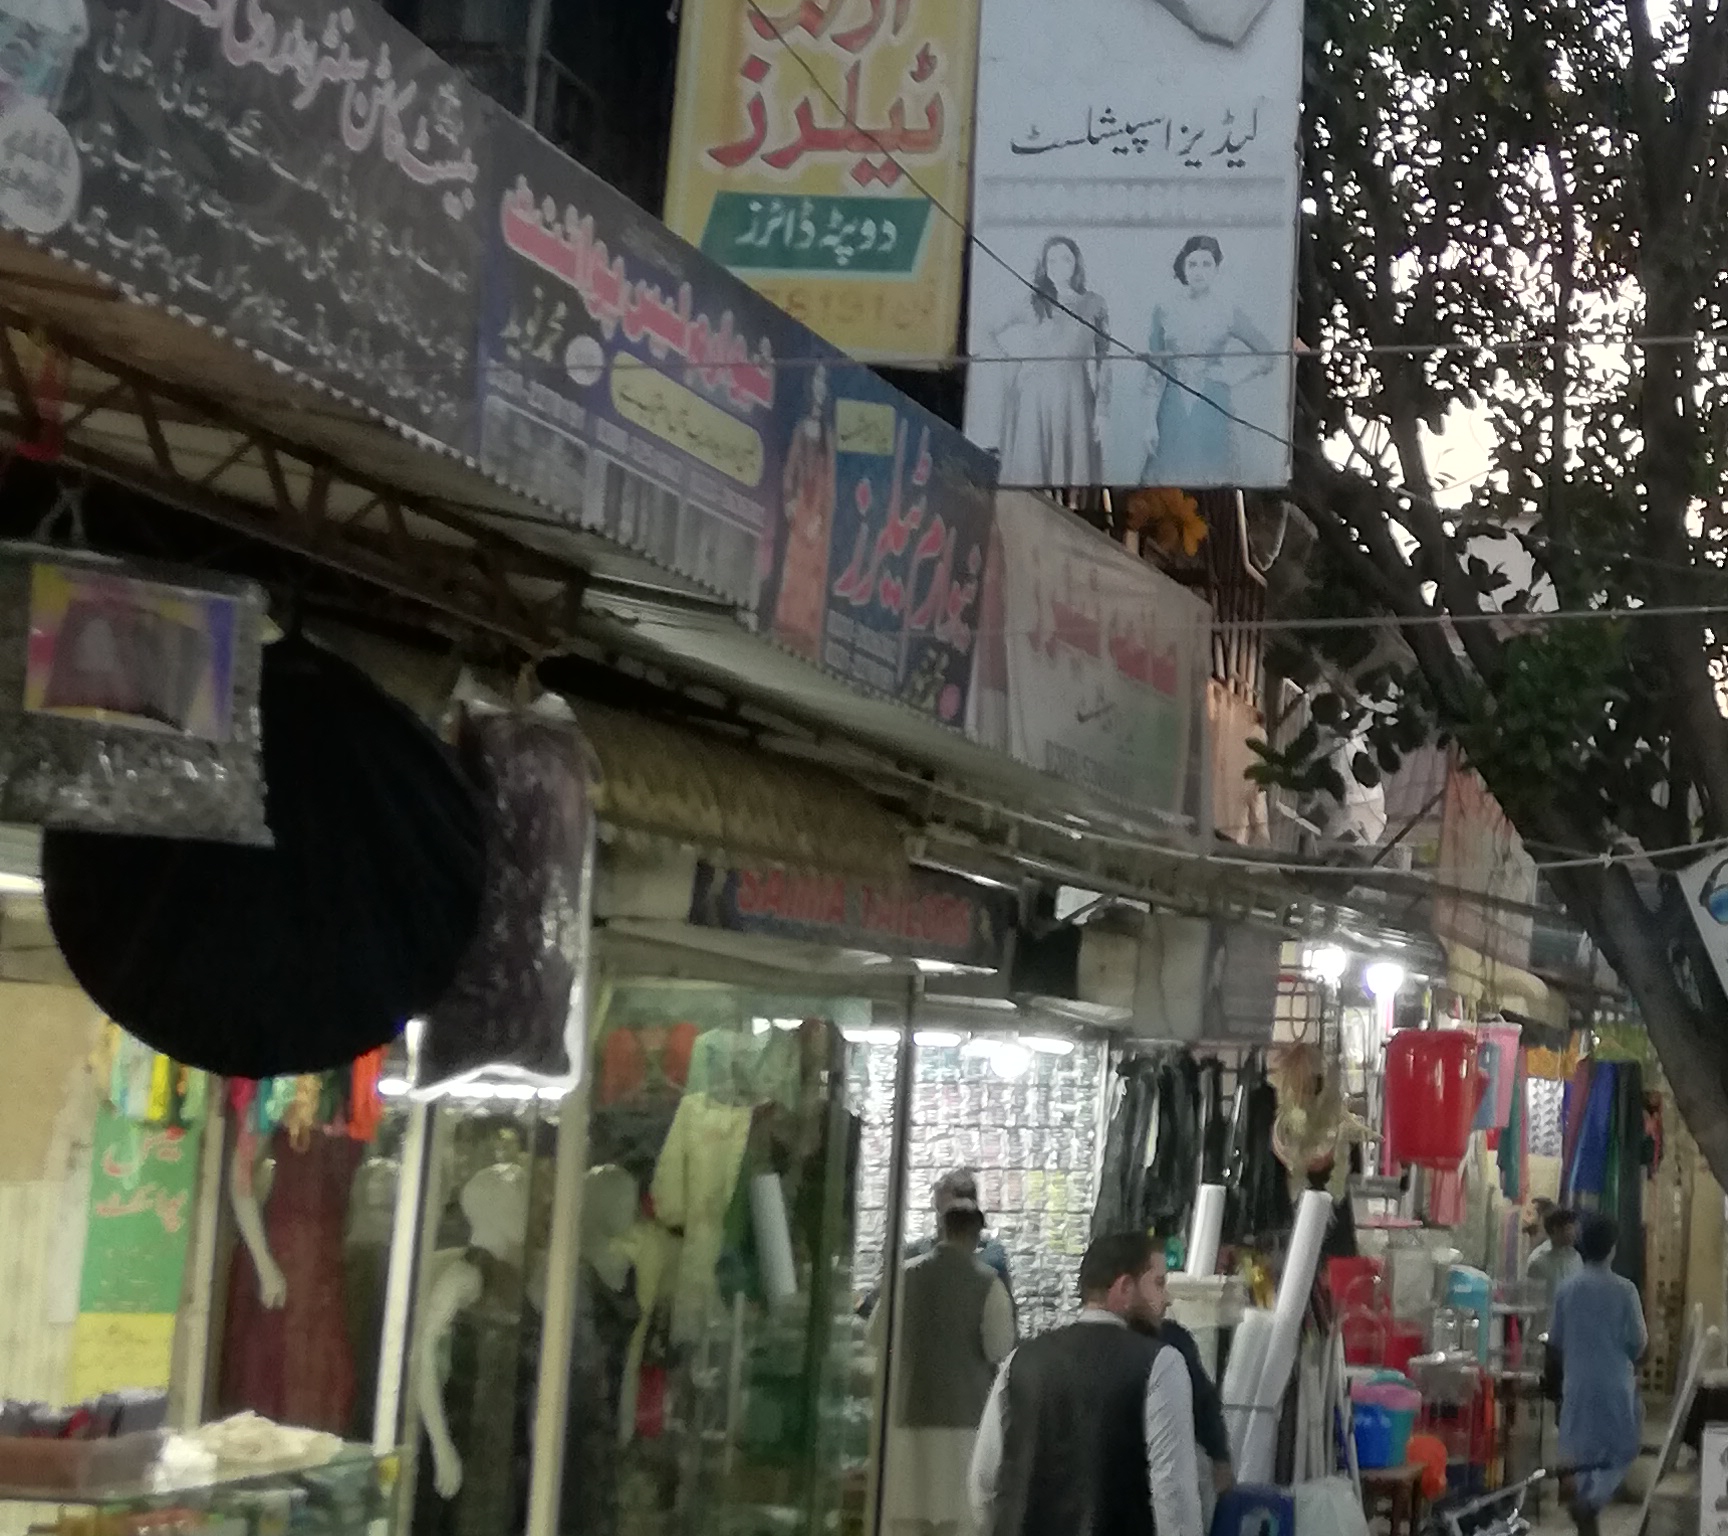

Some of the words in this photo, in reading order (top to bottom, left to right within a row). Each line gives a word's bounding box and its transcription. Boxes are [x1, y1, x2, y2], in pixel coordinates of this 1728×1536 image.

[707, 41, 946, 188] ٹیلرز
[1010, 105, 1172, 156] اسپیشلسٹ
[1178, 106, 1259, 170] لیڈیز
[820, 204, 898, 266] دوپٹہ
